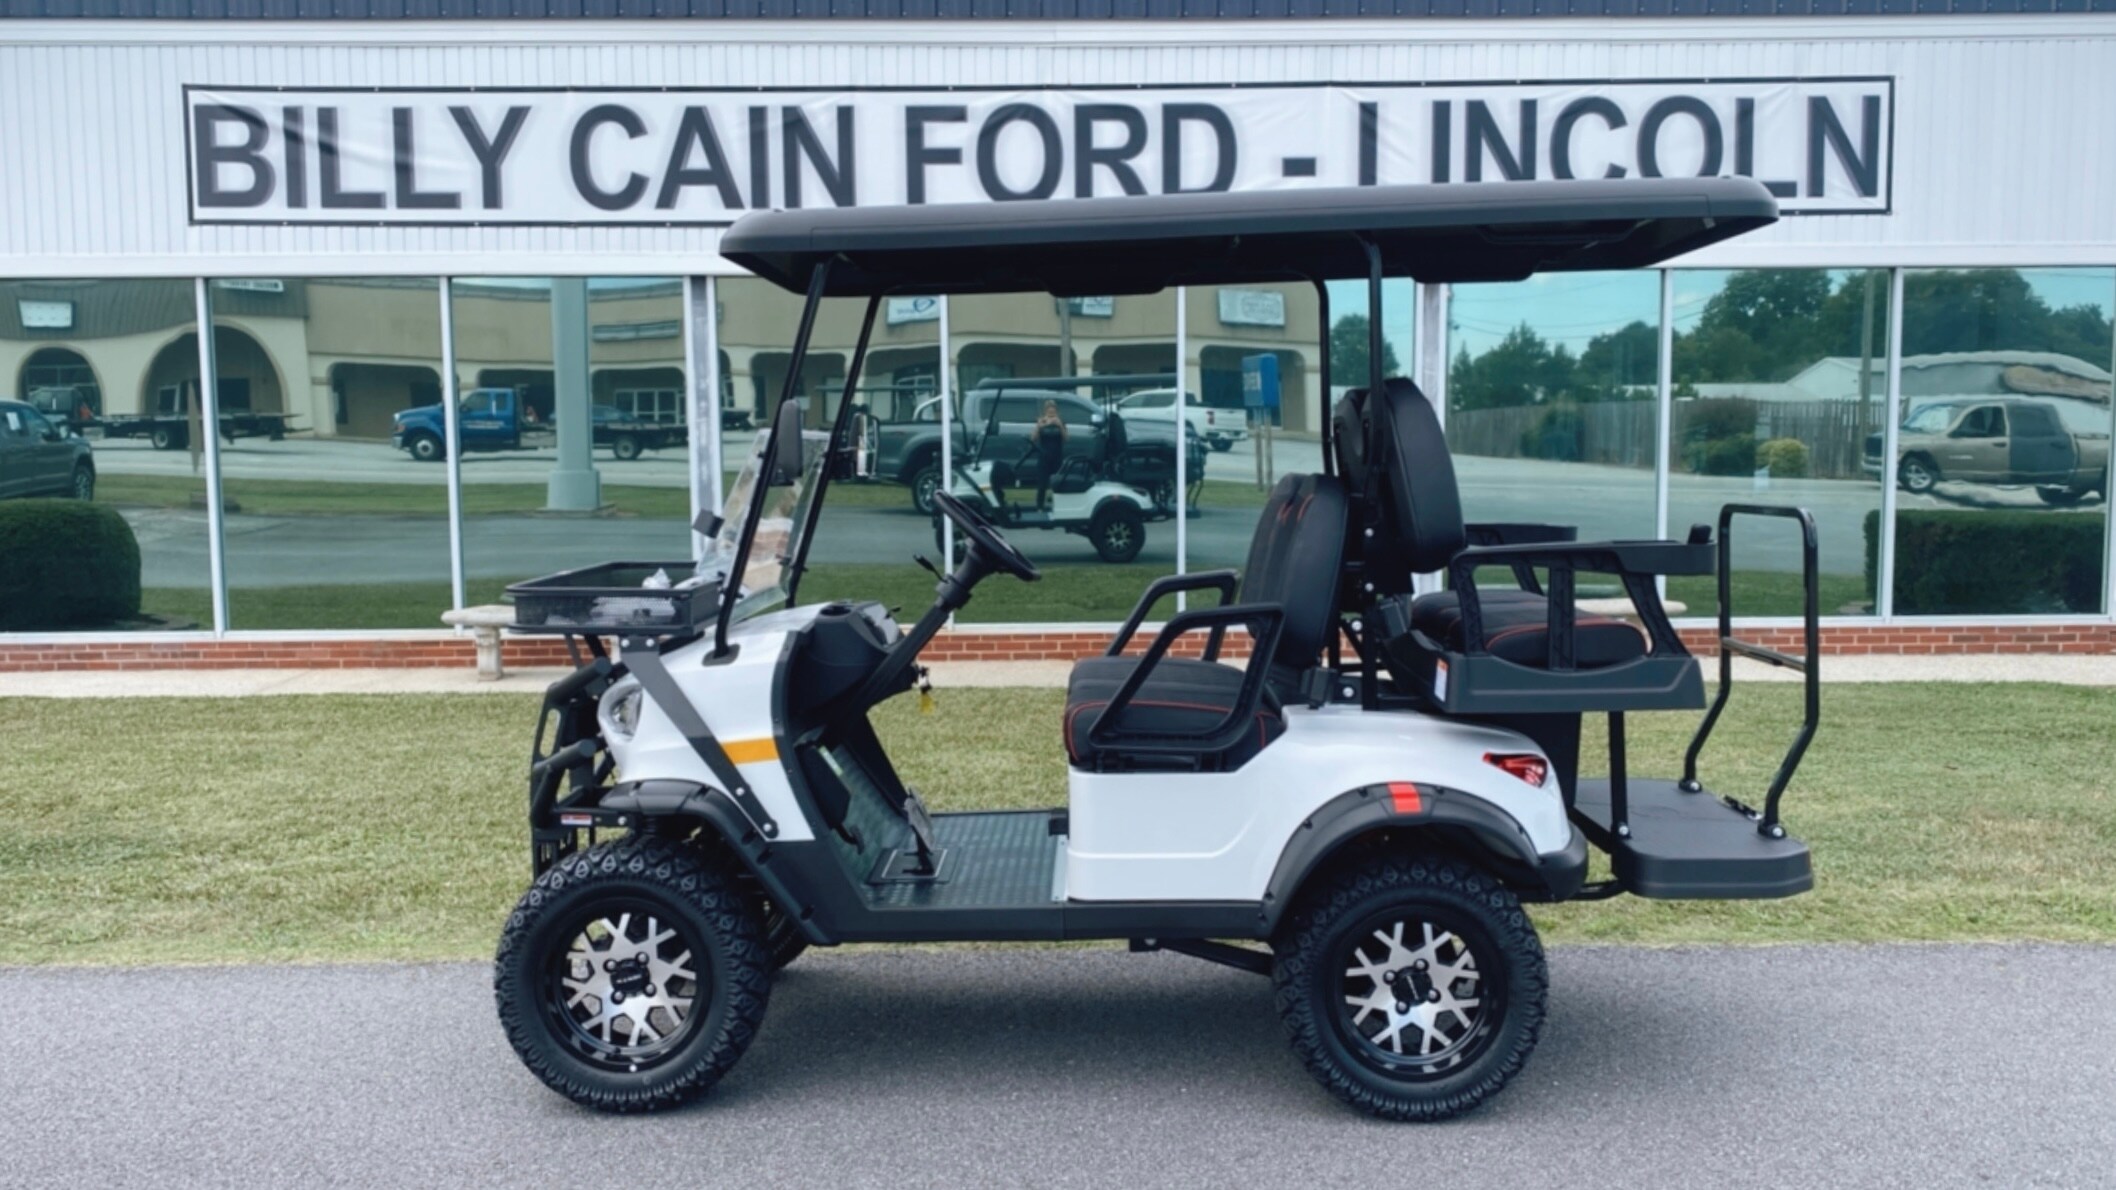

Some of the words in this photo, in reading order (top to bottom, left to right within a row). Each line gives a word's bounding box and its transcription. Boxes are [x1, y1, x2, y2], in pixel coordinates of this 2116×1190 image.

[194, 103, 532, 210] BILLY
[568, 103, 857, 211] CAIN
[904, 102, 1238, 204] FORD
[1282, 157, 1317, 177] -
